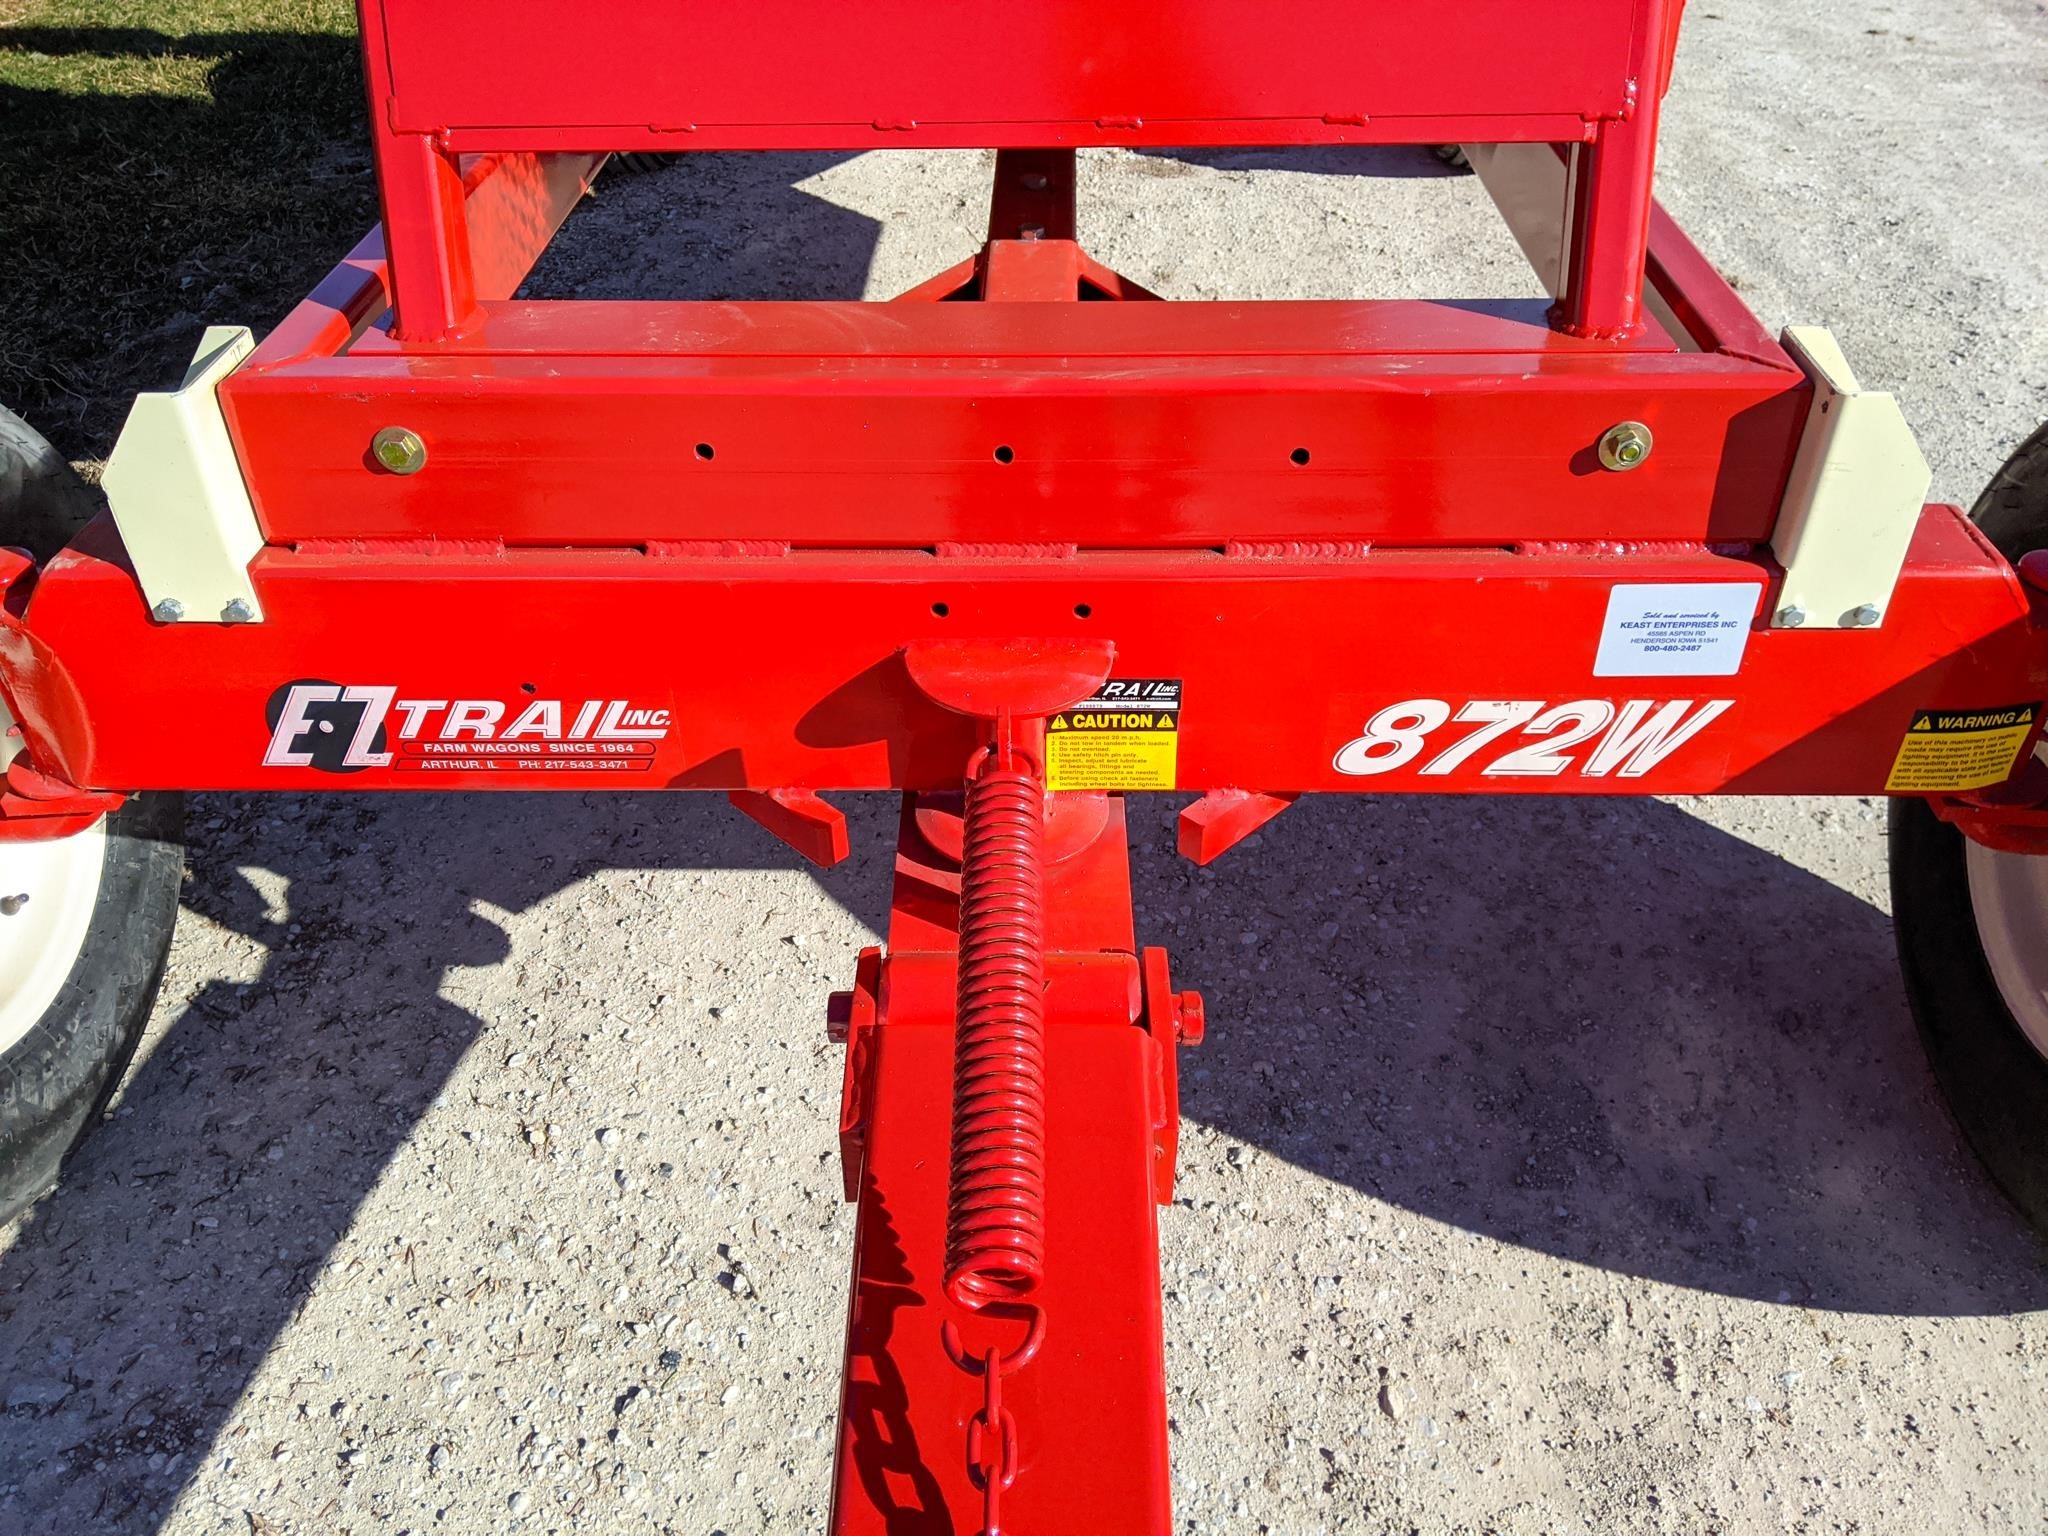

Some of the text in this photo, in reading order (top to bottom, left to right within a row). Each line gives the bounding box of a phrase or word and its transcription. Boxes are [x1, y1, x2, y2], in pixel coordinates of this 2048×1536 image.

[1710, 611, 1720, 620] by
[1101, 682, 1176, 696] RAIL
[395, 699, 669, 740] TRAIL
[622, 709, 672, 727] INC.
[1072, 714, 1153, 728] CAUTION
[1938, 712, 2016, 729] WARNING
[1332, 698, 1736, 778] 872W
[424, 743, 634, 753] FARM WAGONS SINCE 1964
[488, 760, 498, 770] IL
[518, 760, 542, 770] PH:
[545, 760, 628, 770] 217-543-3471
[1978, 753, 2013, 763] compliance
